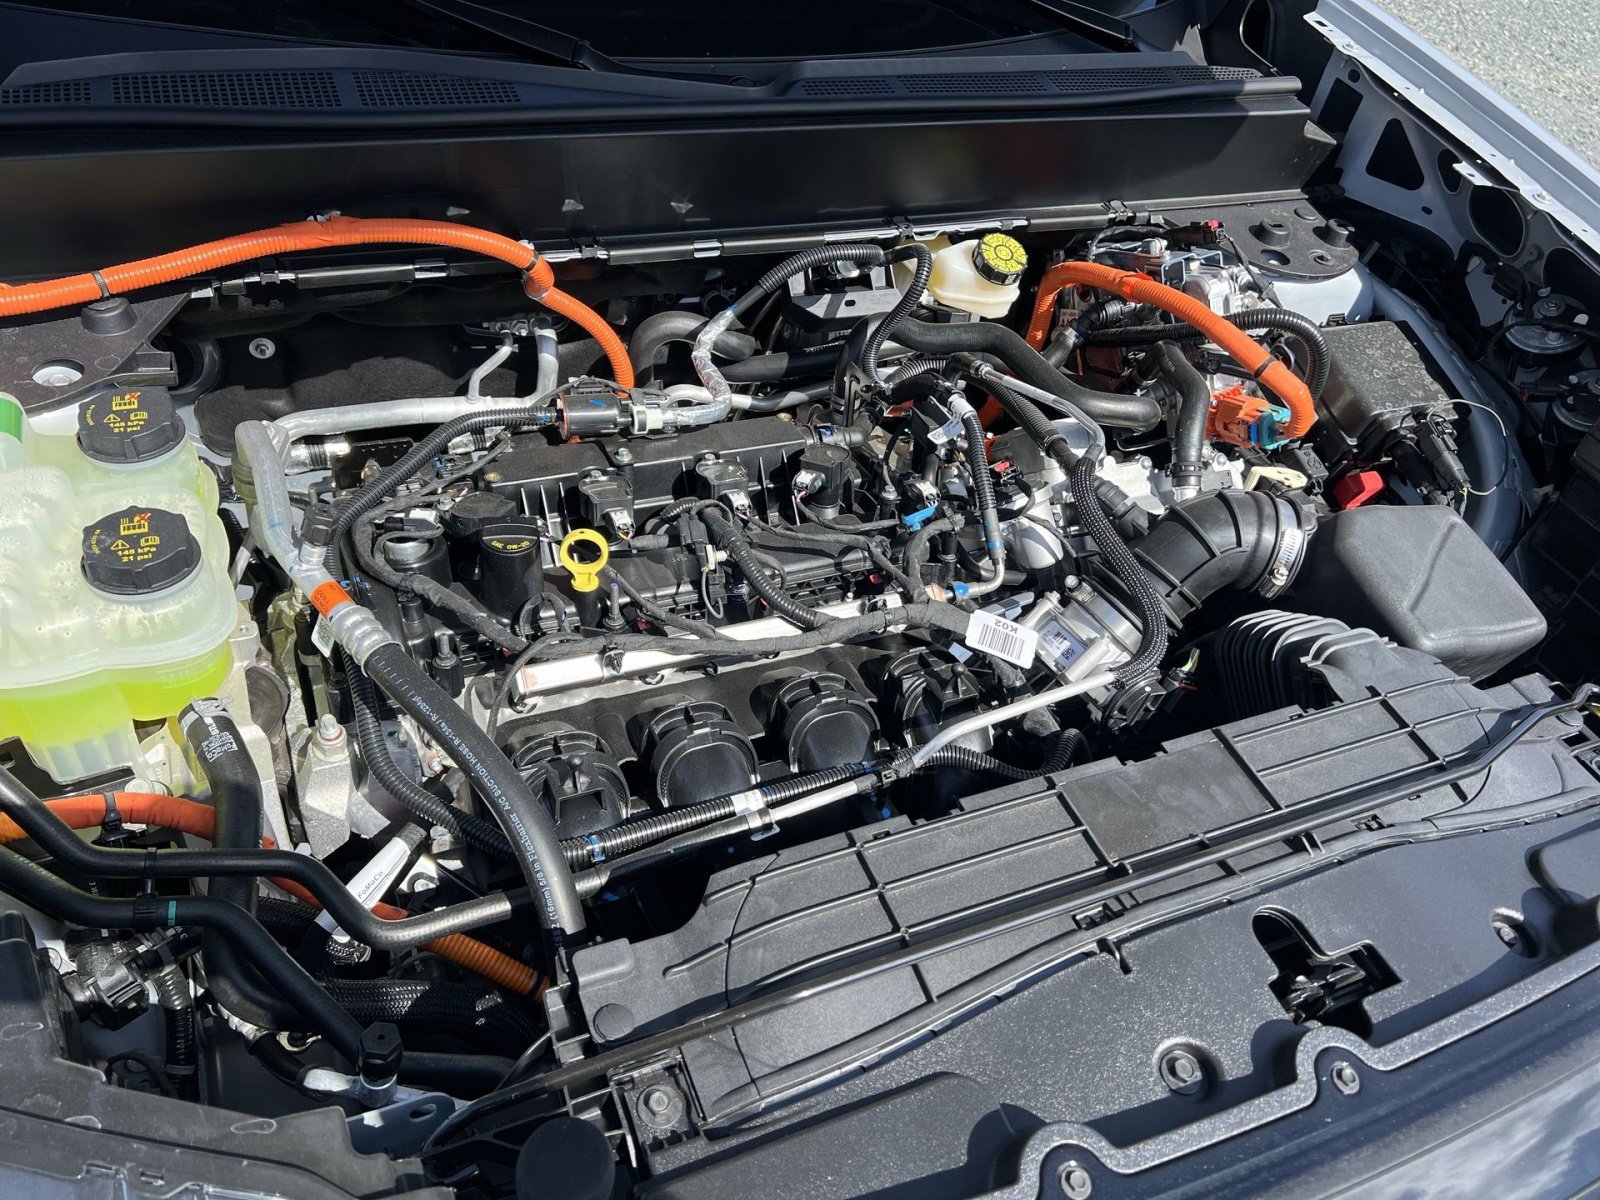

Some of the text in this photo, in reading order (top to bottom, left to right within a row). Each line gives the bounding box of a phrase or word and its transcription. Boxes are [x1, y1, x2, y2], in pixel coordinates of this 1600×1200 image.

[491, 540, 504, 549] SAE
[994, 619, 1018, 634] K02
[440, 722, 461, 745] R-134a
[207, 742, 237, 759] FoMoCo
[458, 743, 478, 764] HOSE
[475, 763, 502, 796] SUCTION
[499, 796, 511, 811] A/C
[509, 813, 537, 861] Flexbarrier
[357, 871, 384, 899] FoMoCo
[536, 872, 547, 886] 5/8
[542, 887, 558, 920] (16mm)
